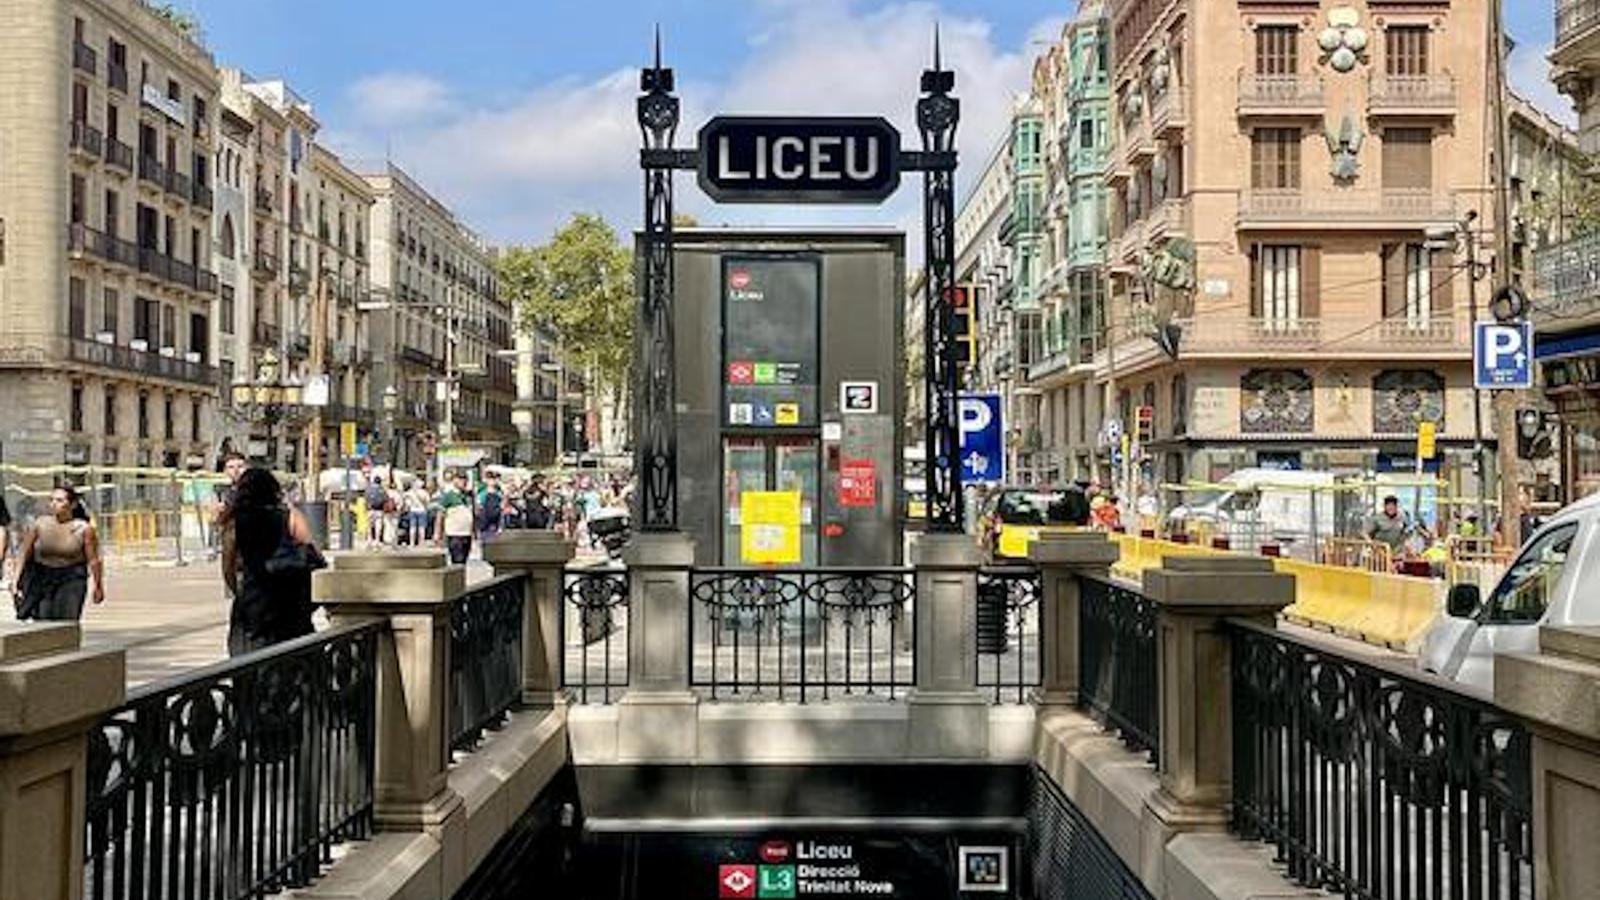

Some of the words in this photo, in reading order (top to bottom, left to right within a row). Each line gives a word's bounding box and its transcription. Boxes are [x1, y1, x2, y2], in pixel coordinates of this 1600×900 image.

[718, 135, 879, 180] LICEU
[1484, 326, 1521, 368] P
[956, 399, 992, 449] P
[796, 840, 853, 859] Liceu
[761, 870, 791, 891] L3
[797, 863, 861, 878] Direcció
[797, 880, 851, 894] Trinitat
[854, 880, 894, 894] Nova
